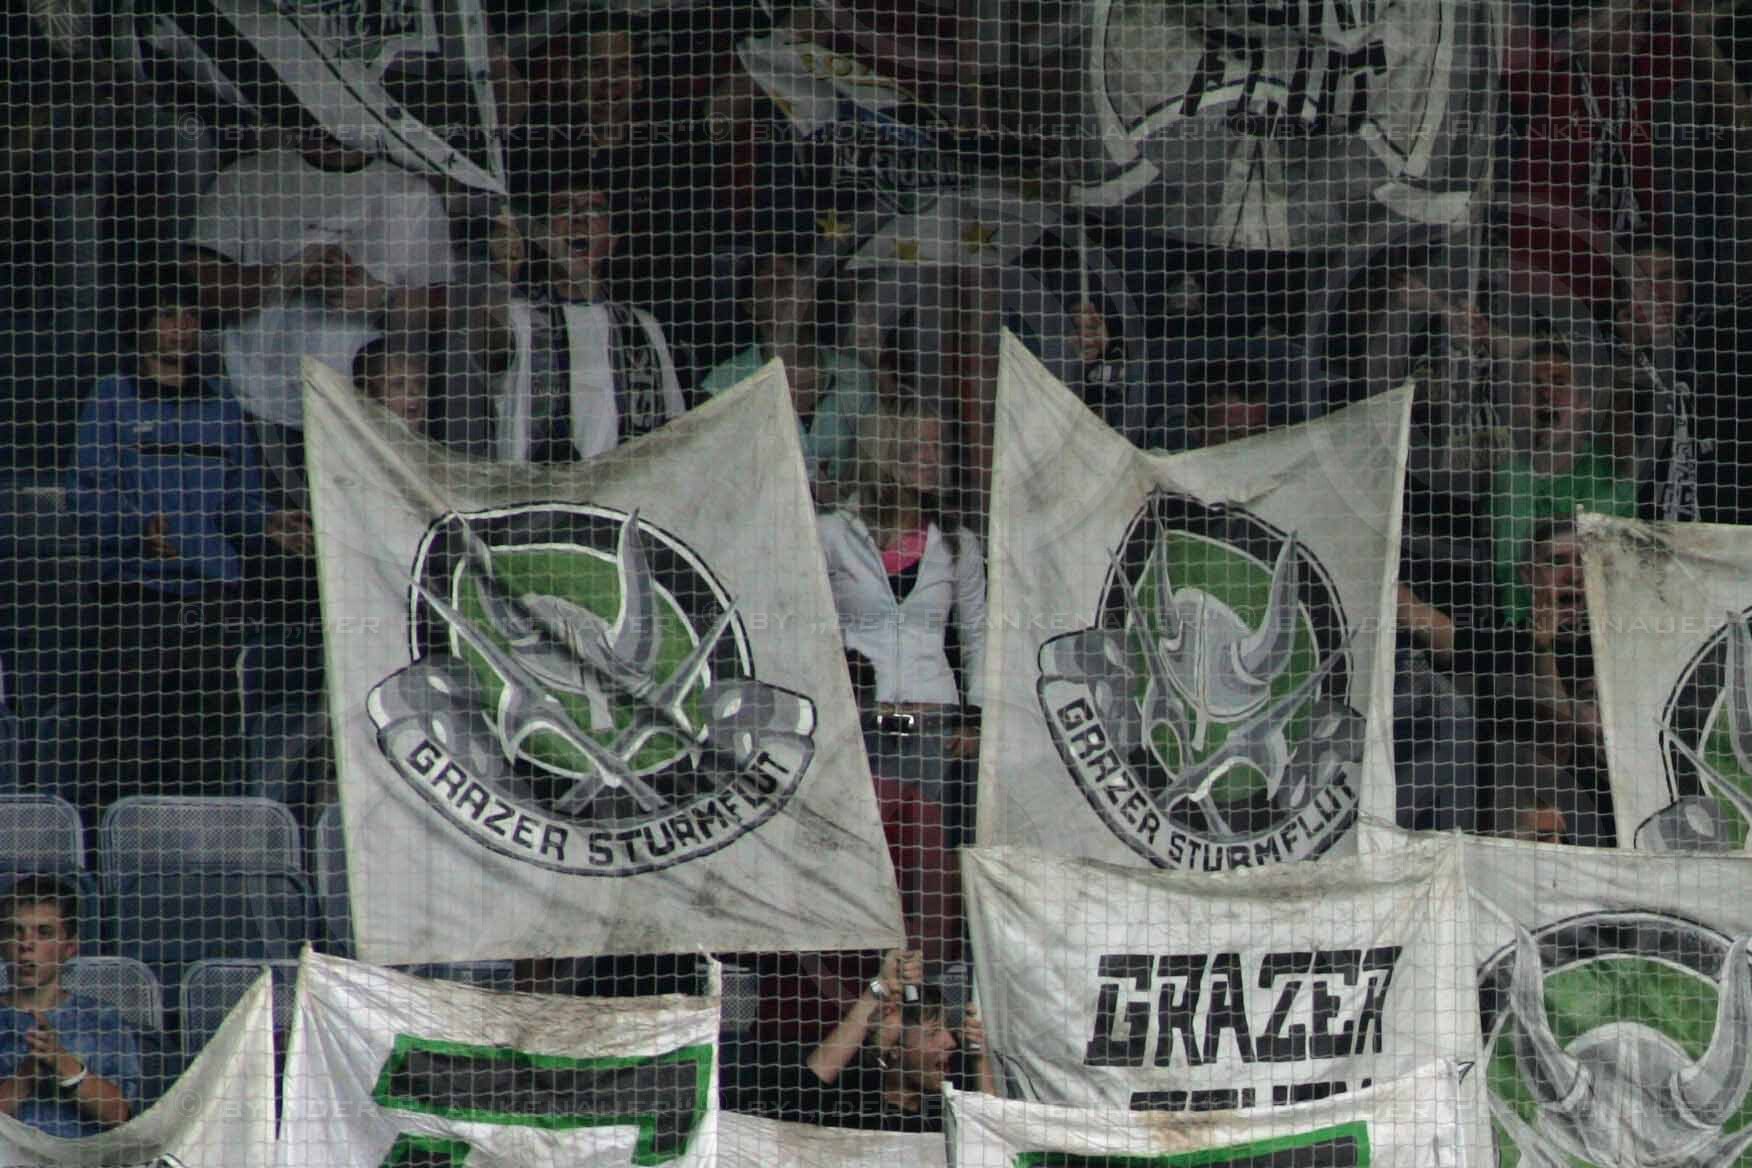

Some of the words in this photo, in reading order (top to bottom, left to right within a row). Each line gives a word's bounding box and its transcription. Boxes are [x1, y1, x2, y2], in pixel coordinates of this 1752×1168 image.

[407, 739, 569, 861] GRAZER
[588, 751, 791, 866] STURMFLUT
[1056, 697, 1161, 844] GRAZER
[1083, 946, 1403, 1067] GRAZER
